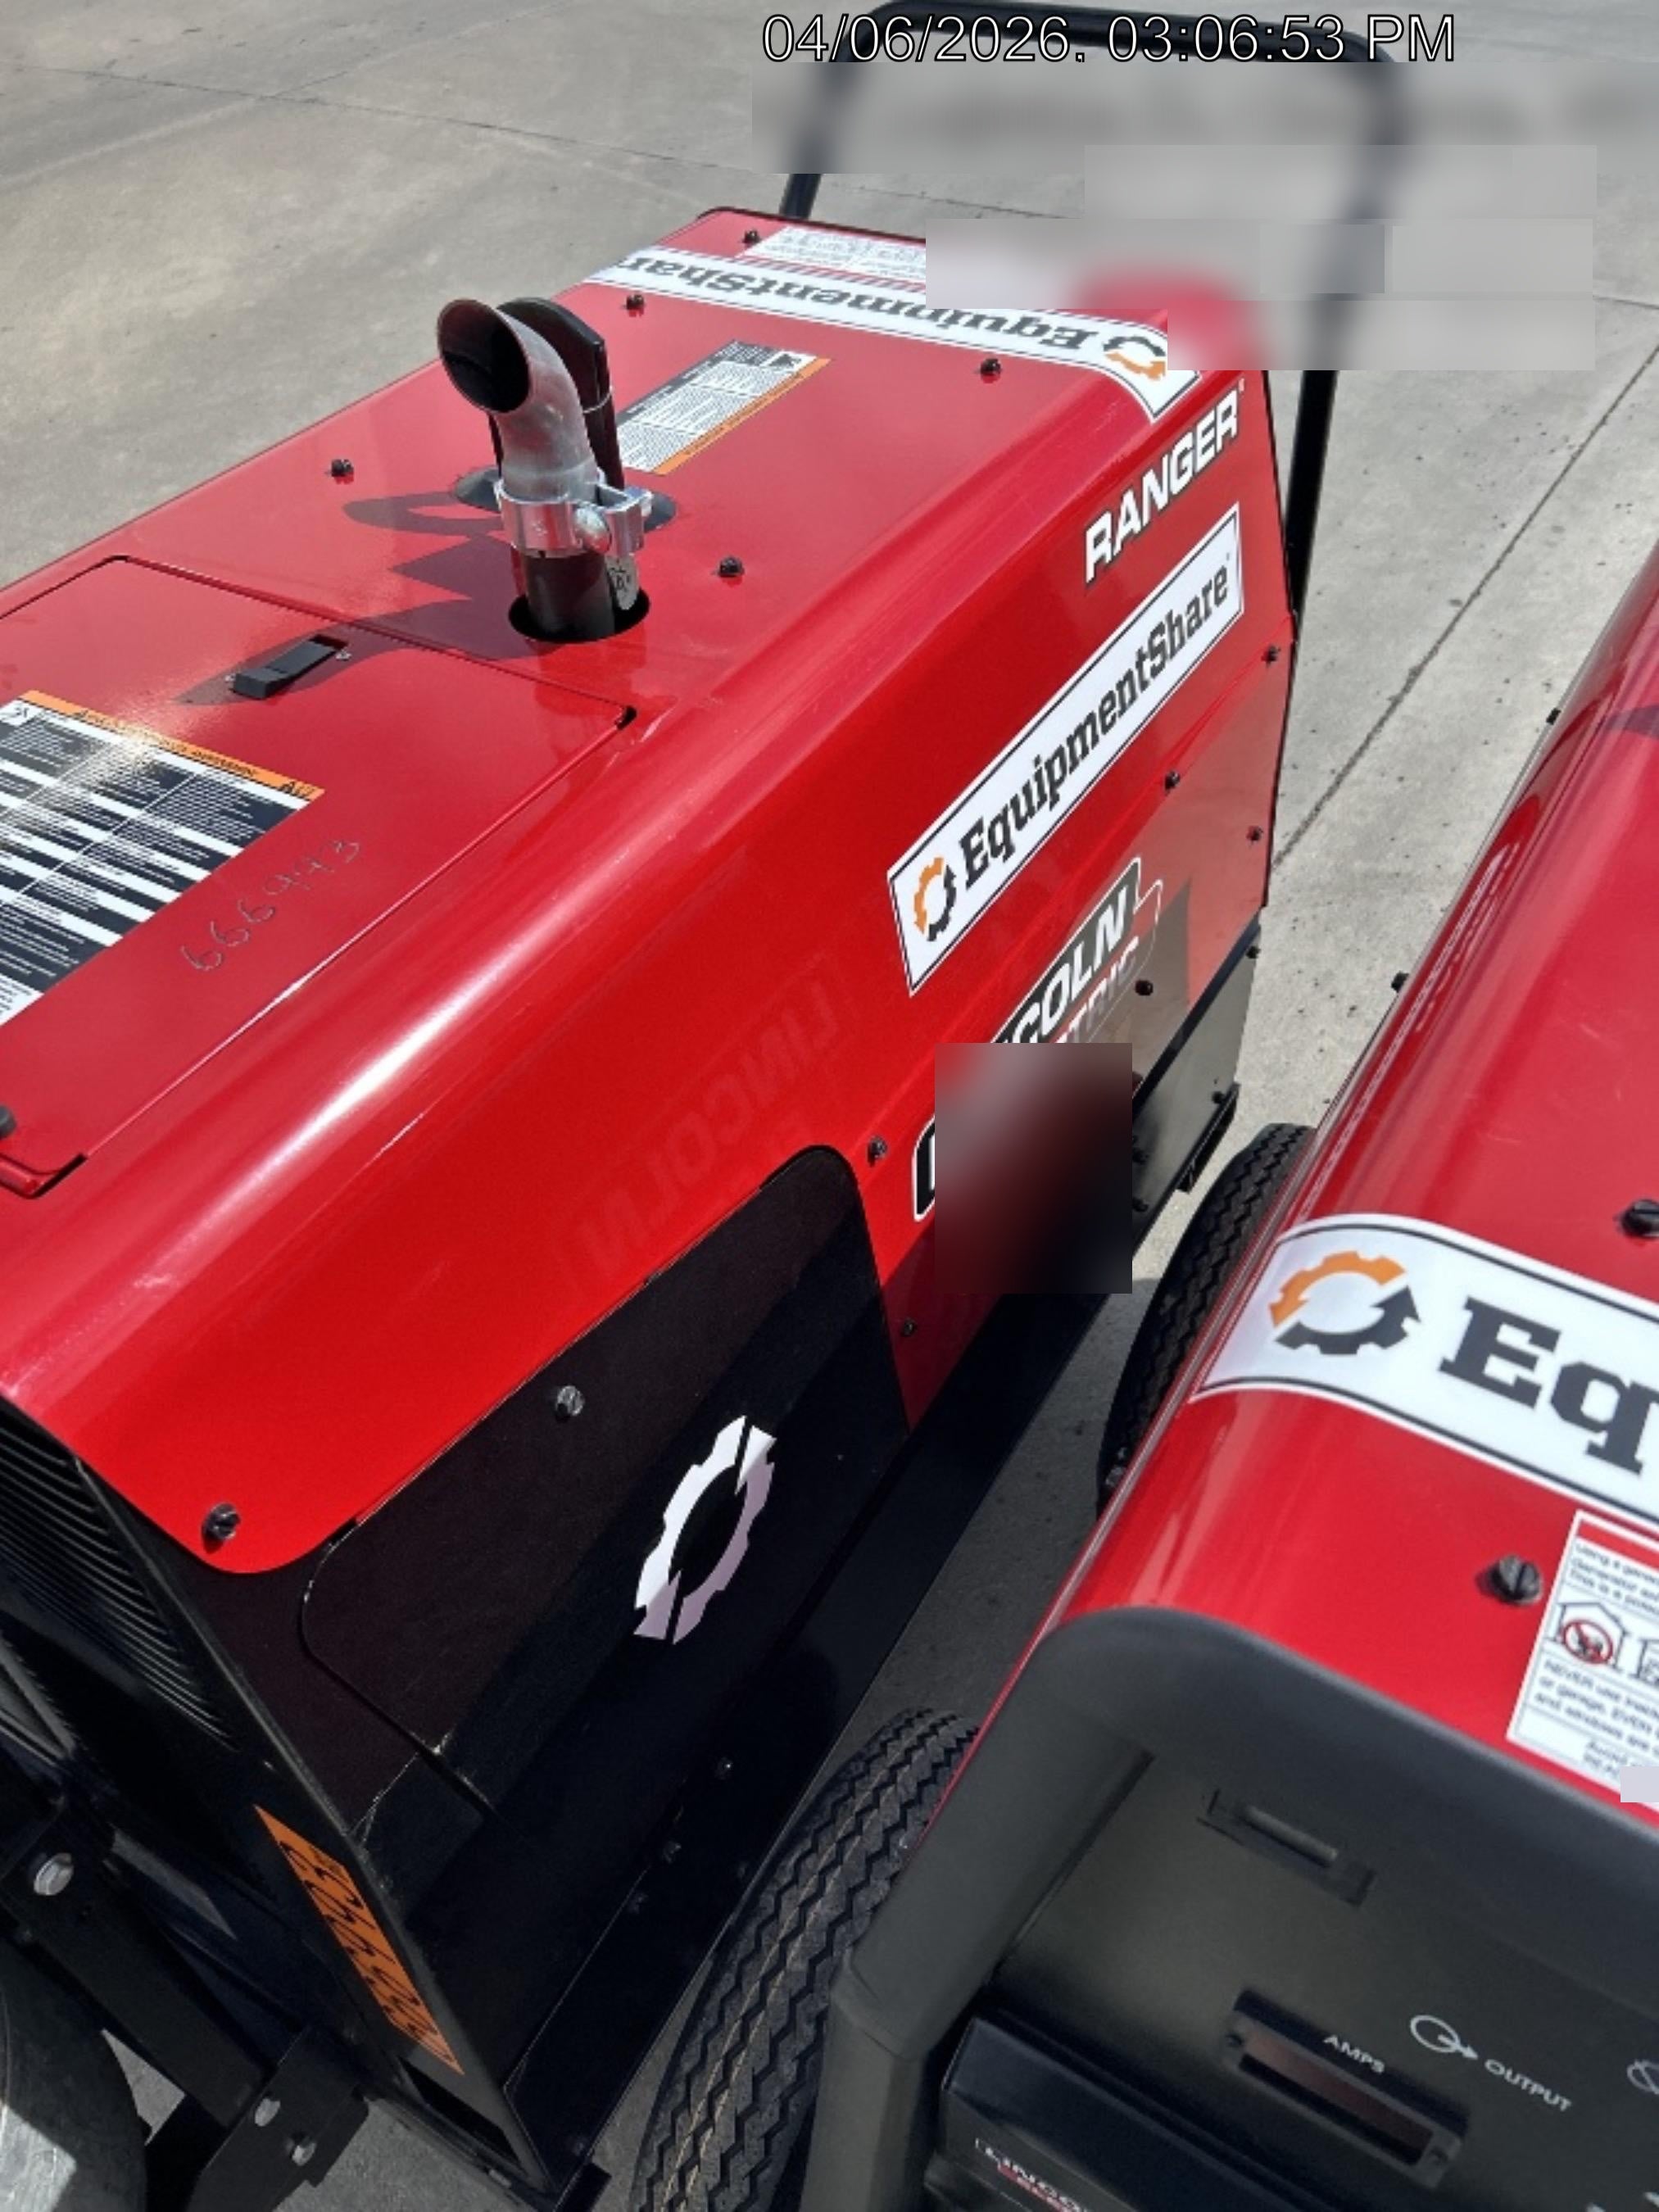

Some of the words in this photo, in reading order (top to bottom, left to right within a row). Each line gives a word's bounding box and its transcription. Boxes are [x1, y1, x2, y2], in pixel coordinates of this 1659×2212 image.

[1086, 390, 1238, 584] RANGER
[959, 565, 1228, 891] EquipmentShare
[1439, 1296, 1659, 1476] Eq
[1324, 2033, 1385, 2074] AMPS
[1484, 2059, 1571, 2111] OUTPUT
